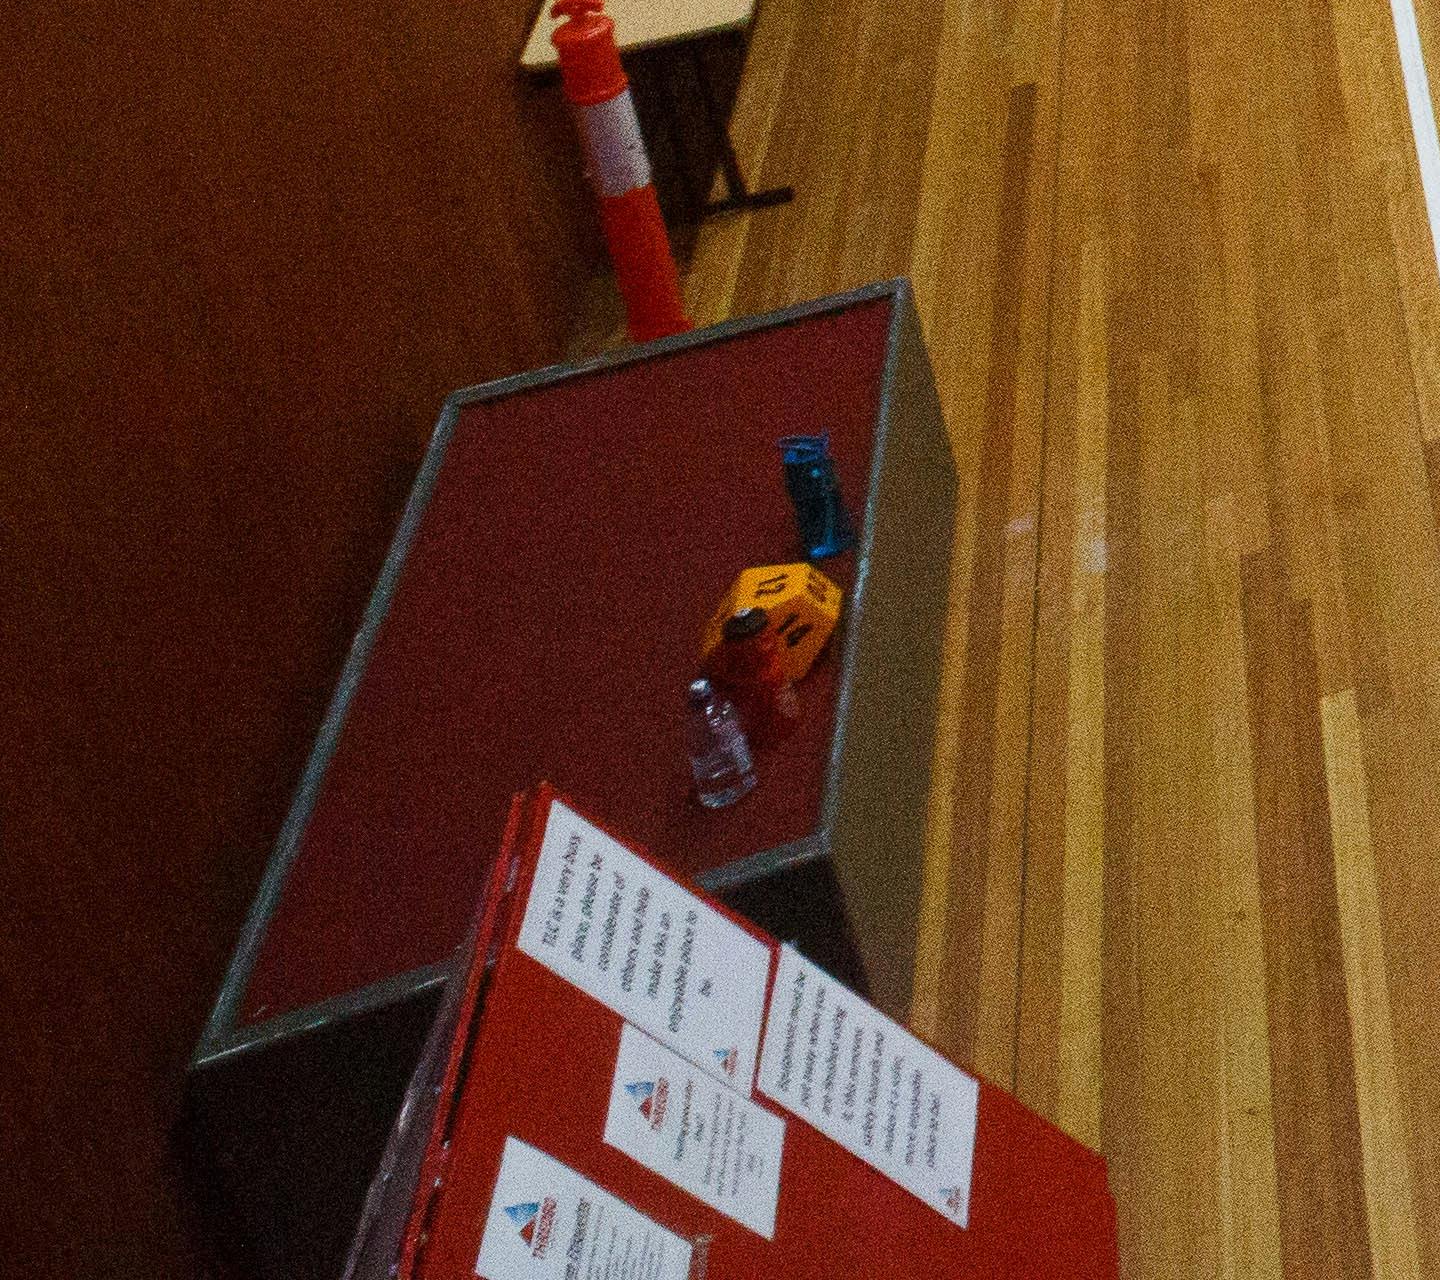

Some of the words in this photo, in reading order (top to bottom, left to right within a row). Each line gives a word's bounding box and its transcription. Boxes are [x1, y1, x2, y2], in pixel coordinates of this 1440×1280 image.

[562, 833, 581, 864] busy
[589, 853, 603, 871] be
[557, 864, 573, 894] very
[554, 896, 565, 908] a
[581, 872, 598, 918] please
[549, 908, 562, 921] is
[685, 910, 697, 925] to
[647, 959, 663, 998] make
[659, 912, 670, 930] an
